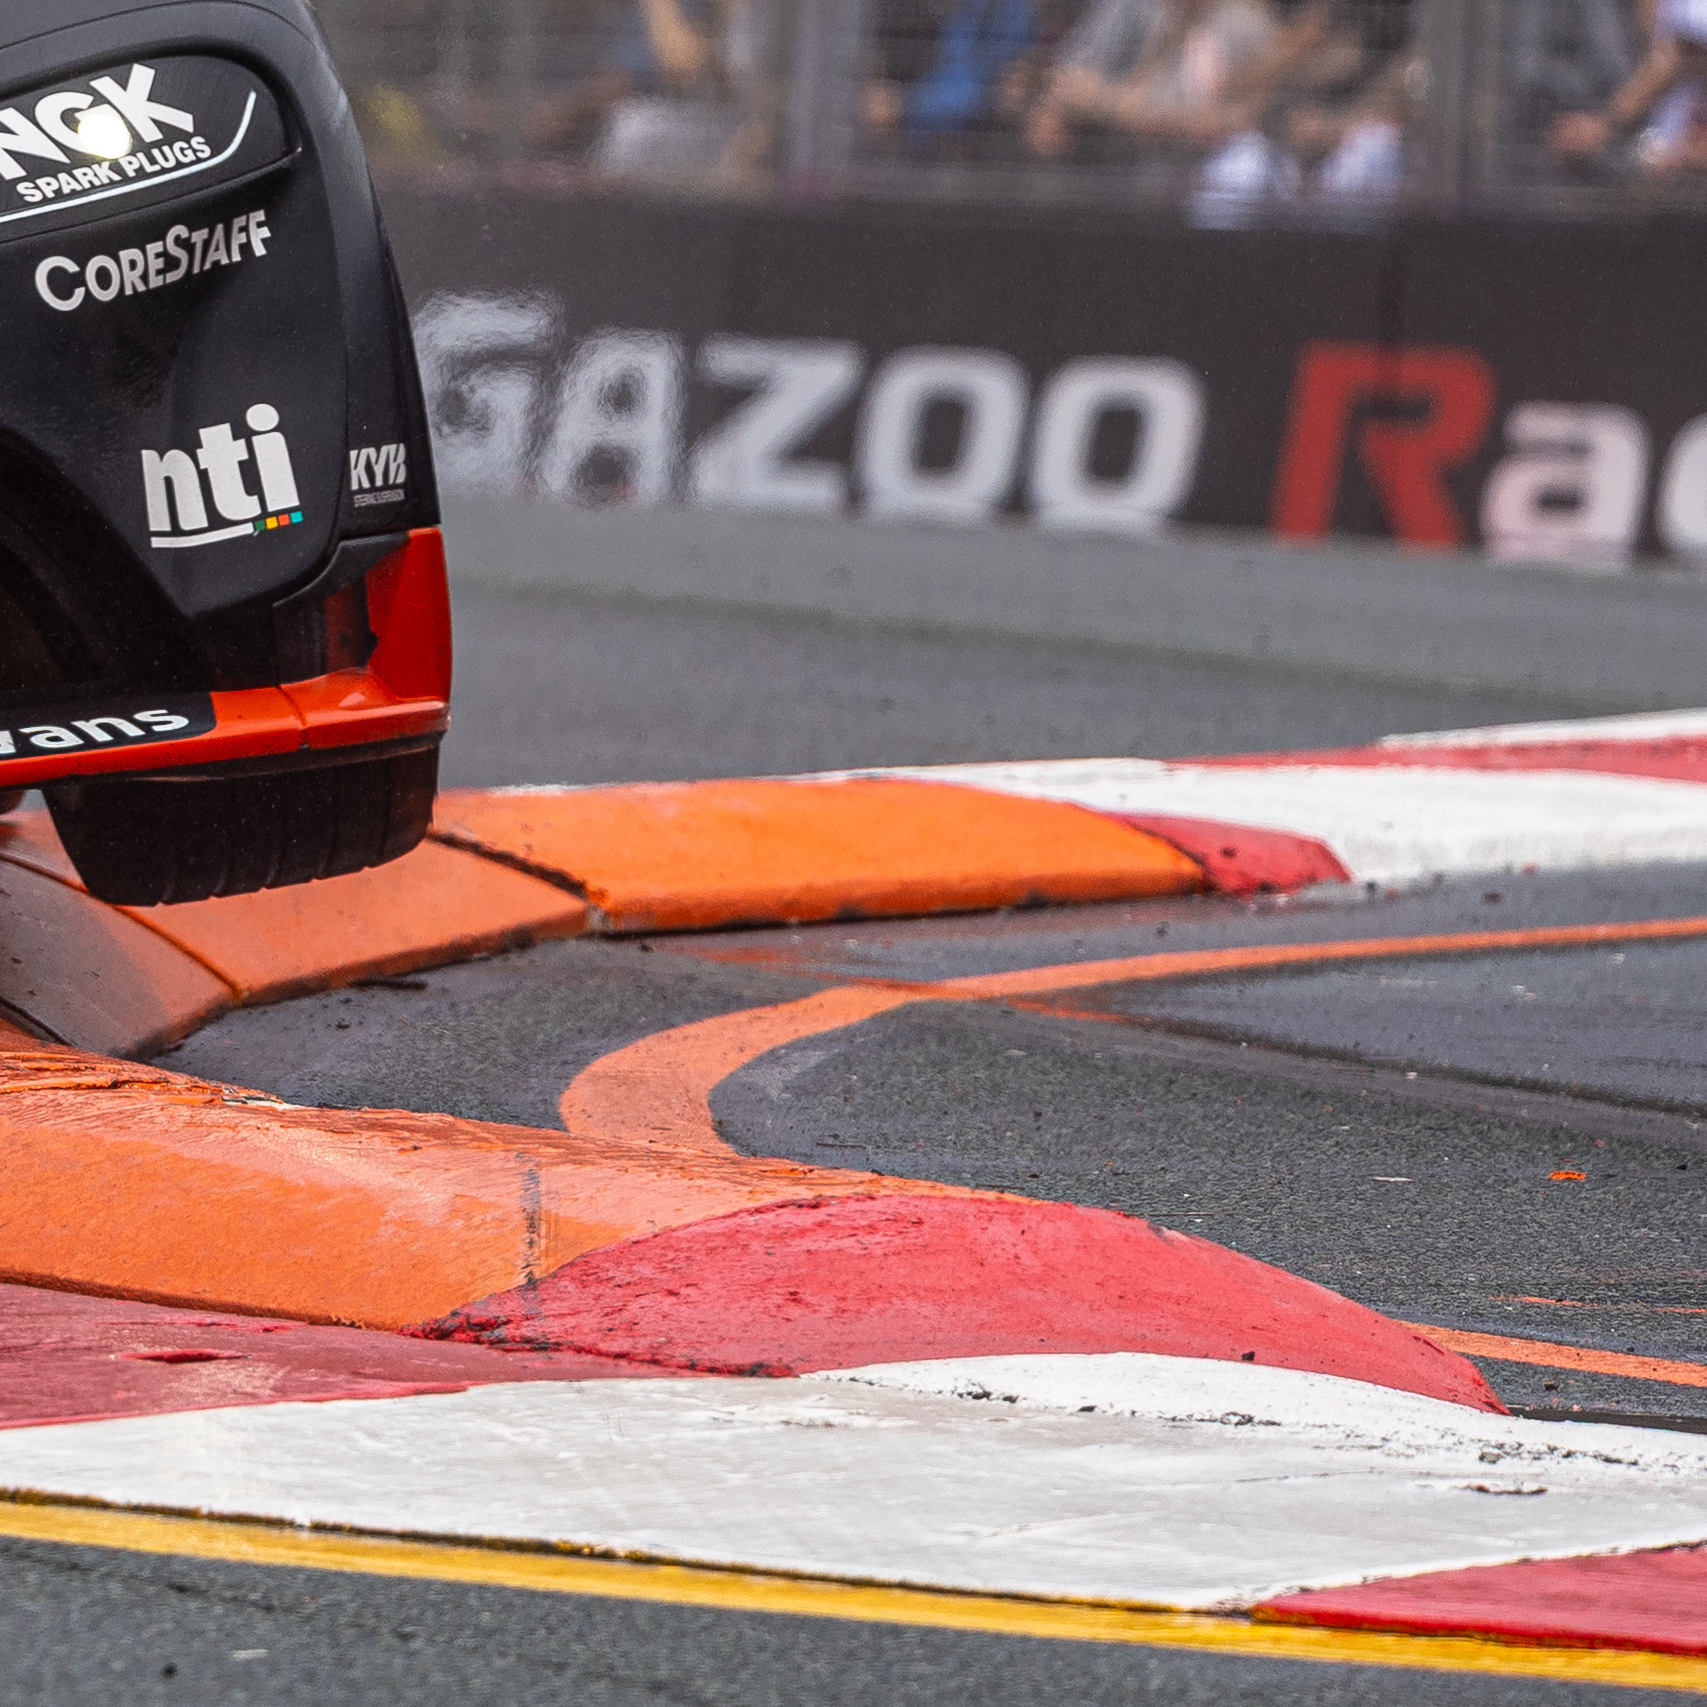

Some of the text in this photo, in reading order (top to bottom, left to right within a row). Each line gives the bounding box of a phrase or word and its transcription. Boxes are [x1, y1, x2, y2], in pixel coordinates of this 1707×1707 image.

[17, 135, 213, 204] SPARK PLUGS
[413, 290, 1202, 534] GAZOO
[141, 403, 301, 533] nti
[349, 442, 407, 491] KYB
